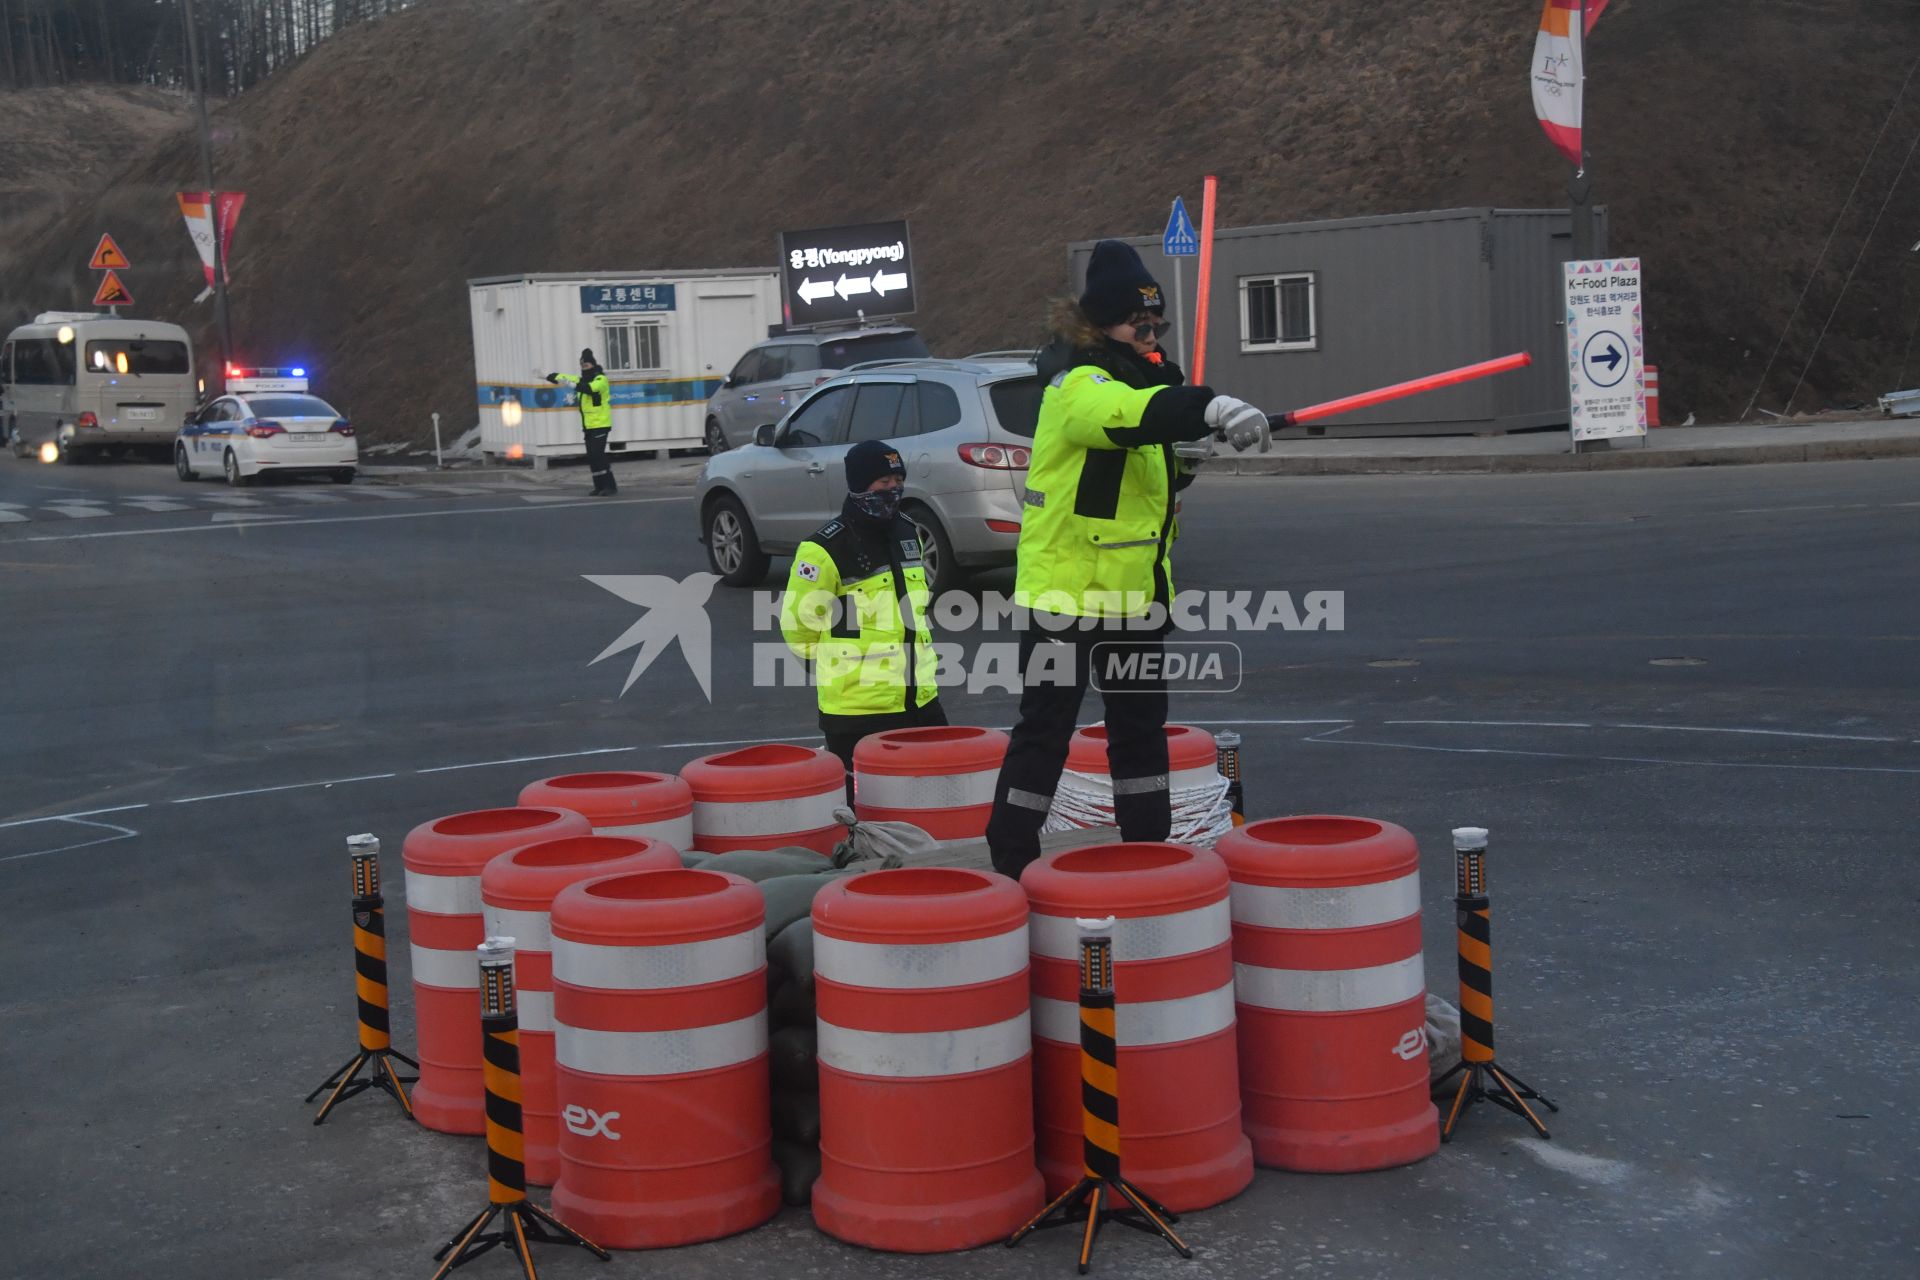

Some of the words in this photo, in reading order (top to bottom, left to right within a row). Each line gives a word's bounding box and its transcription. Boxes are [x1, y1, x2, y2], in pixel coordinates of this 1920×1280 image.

[790, 241, 905, 269] 용평(Yongpyong)
[1568, 276, 1607, 290] K-Food
[1610, 276, 1638, 288] Plaza
[600, 287, 656, 303] 교통센터
[1569, 294, 1591, 306] 강원도
[1592, 293, 1607, 304] 대표
[590, 303, 609, 311] Traffic
[610, 303, 647, 311] Information
[647, 302, 669, 310] Center
[562, 1104, 621, 1140] ex
